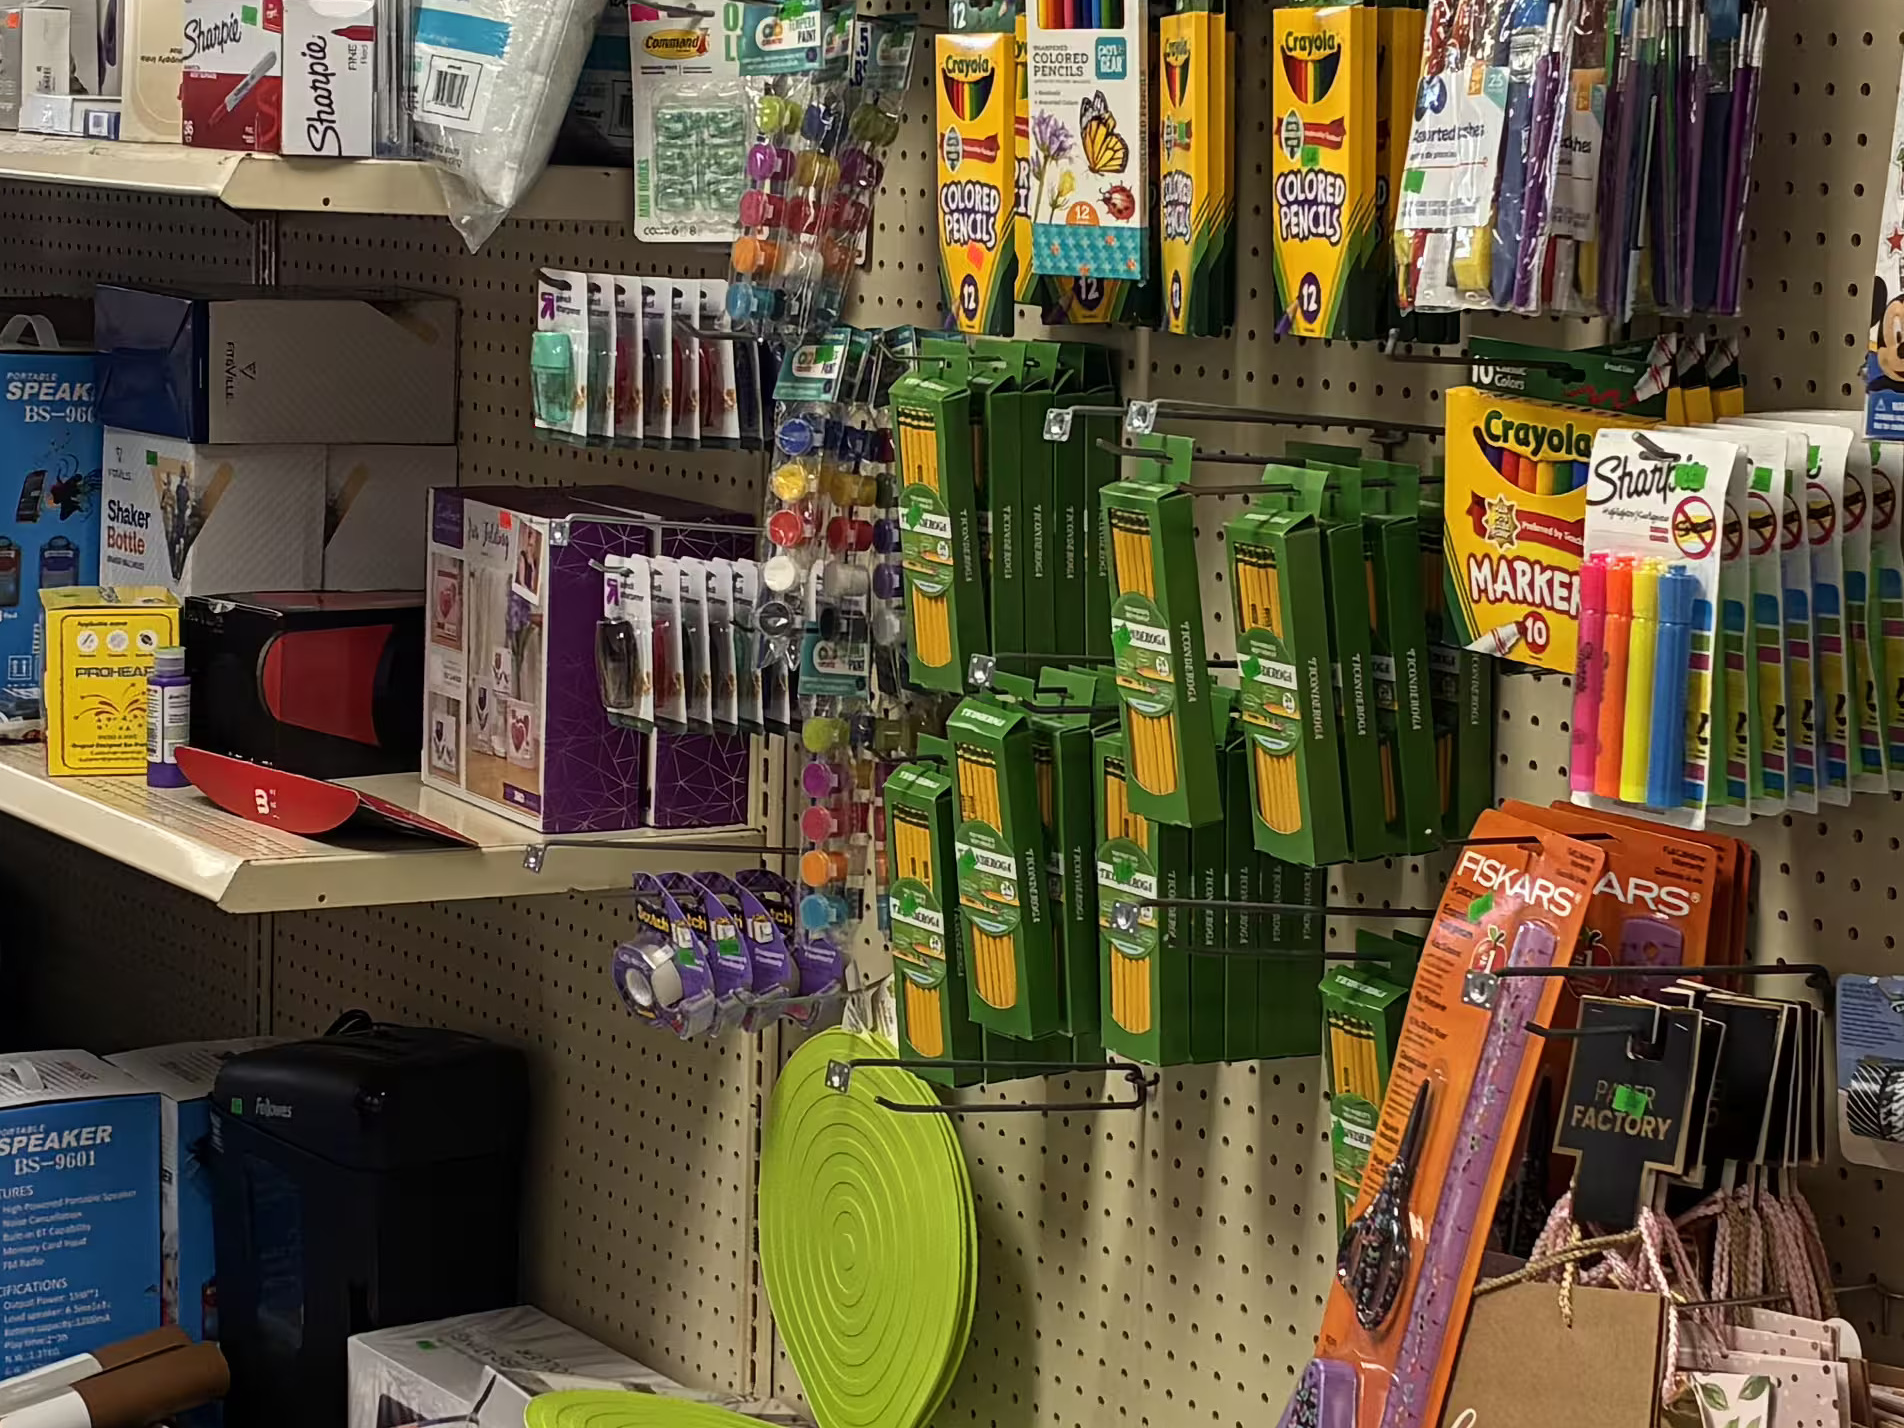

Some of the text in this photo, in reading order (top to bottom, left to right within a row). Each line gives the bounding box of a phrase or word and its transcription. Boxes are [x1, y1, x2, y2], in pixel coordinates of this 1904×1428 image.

[952, 3, 967, 29] 12
[181, 12, 242, 61] Sharpie
[644, 34, 700, 51] Command
[798, 28, 816, 45] PAINT
[1284, 30, 1340, 57] Crayola
[945, 55, 990, 78] Crayola
[1032, 52, 1089, 65] COLORED
[1033, 65, 1084, 77] PENCILS
[301, 34, 343, 157] Sharpie
[940, 181, 1000, 213] COLORED
[1276, 171, 1346, 205] COLORED
[1075, 205, 1090, 220] 12
[1279, 204, 1342, 245] PENCILS
[943, 213, 996, 249] PENCILS
[962, 283, 976, 310] 12
[1302, 281, 1318, 312] 12
[1471, 355, 1493, 385] 10
[1495, 372, 1527, 391] Colors
[5, 381, 95, 403] SPEAK
[1484, 410, 1592, 461] Crayola
[107, 499, 151, 529] Shaker
[106, 526, 146, 556] Bottle
[1525, 617, 1548, 643] 10
[1179, 620, 1197, 703] TICONDEROGA
[1307, 656, 1324, 741] TICONDEROGA
[1350, 652, 1367, 736] TICONDEROGA
[1406, 647, 1422, 731] TICONDEROGA
[1456, 850, 1576, 918] FISKARS
[636, 903, 671, 935] Scotch
[1571, 1104, 1673, 1141] FACTORY
